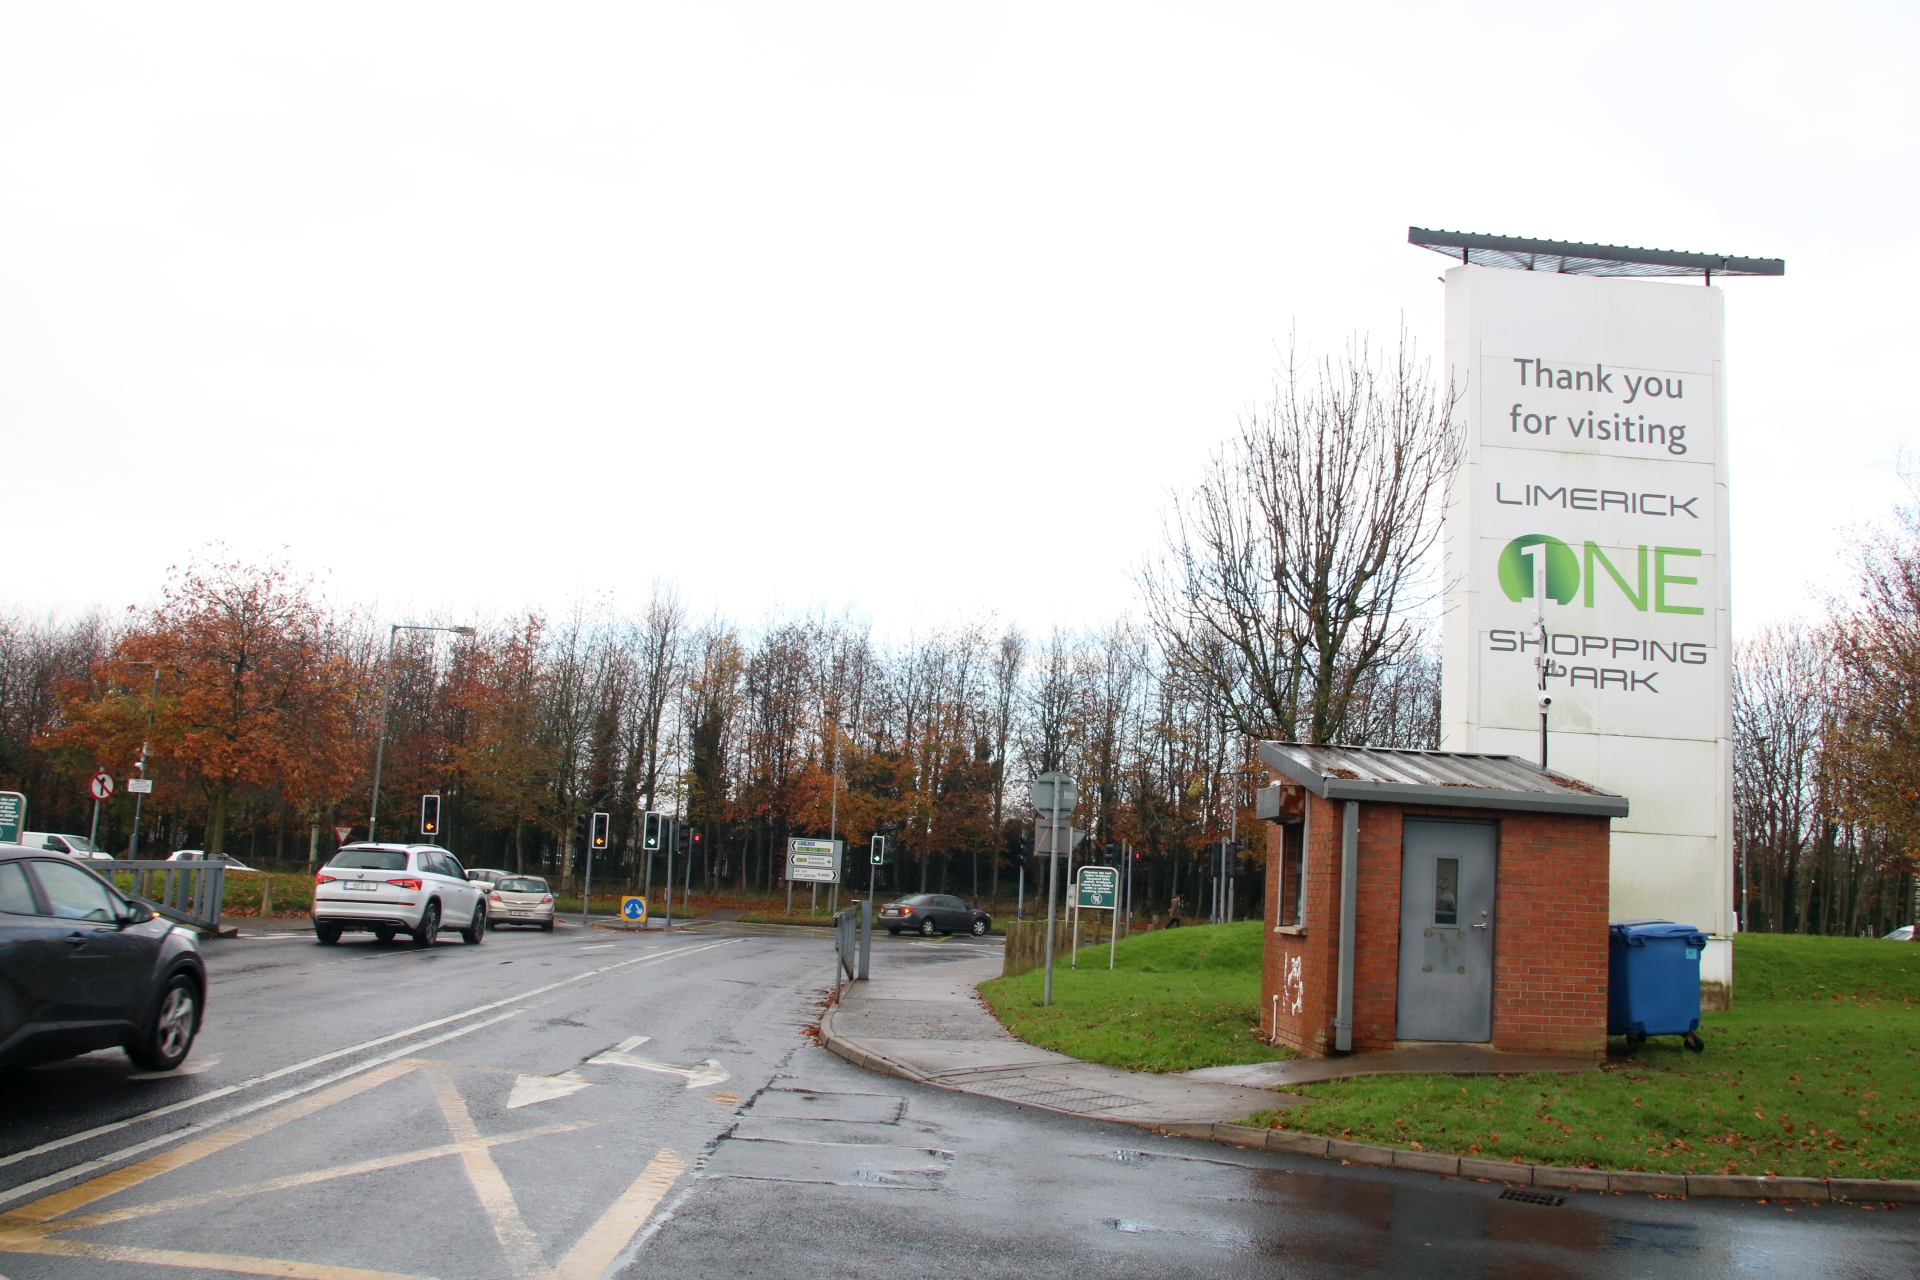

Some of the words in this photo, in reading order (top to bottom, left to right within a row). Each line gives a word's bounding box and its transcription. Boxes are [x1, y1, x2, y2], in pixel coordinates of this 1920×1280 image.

[1513, 358, 1613, 394] Thank
[1623, 374, 1683, 404] you
[1509, 403, 1556, 436] for
[1567, 410, 1687, 455] visiting
[1496, 482, 1699, 519] LIMERICK
[1489, 629, 1707, 665] SHOPPING
